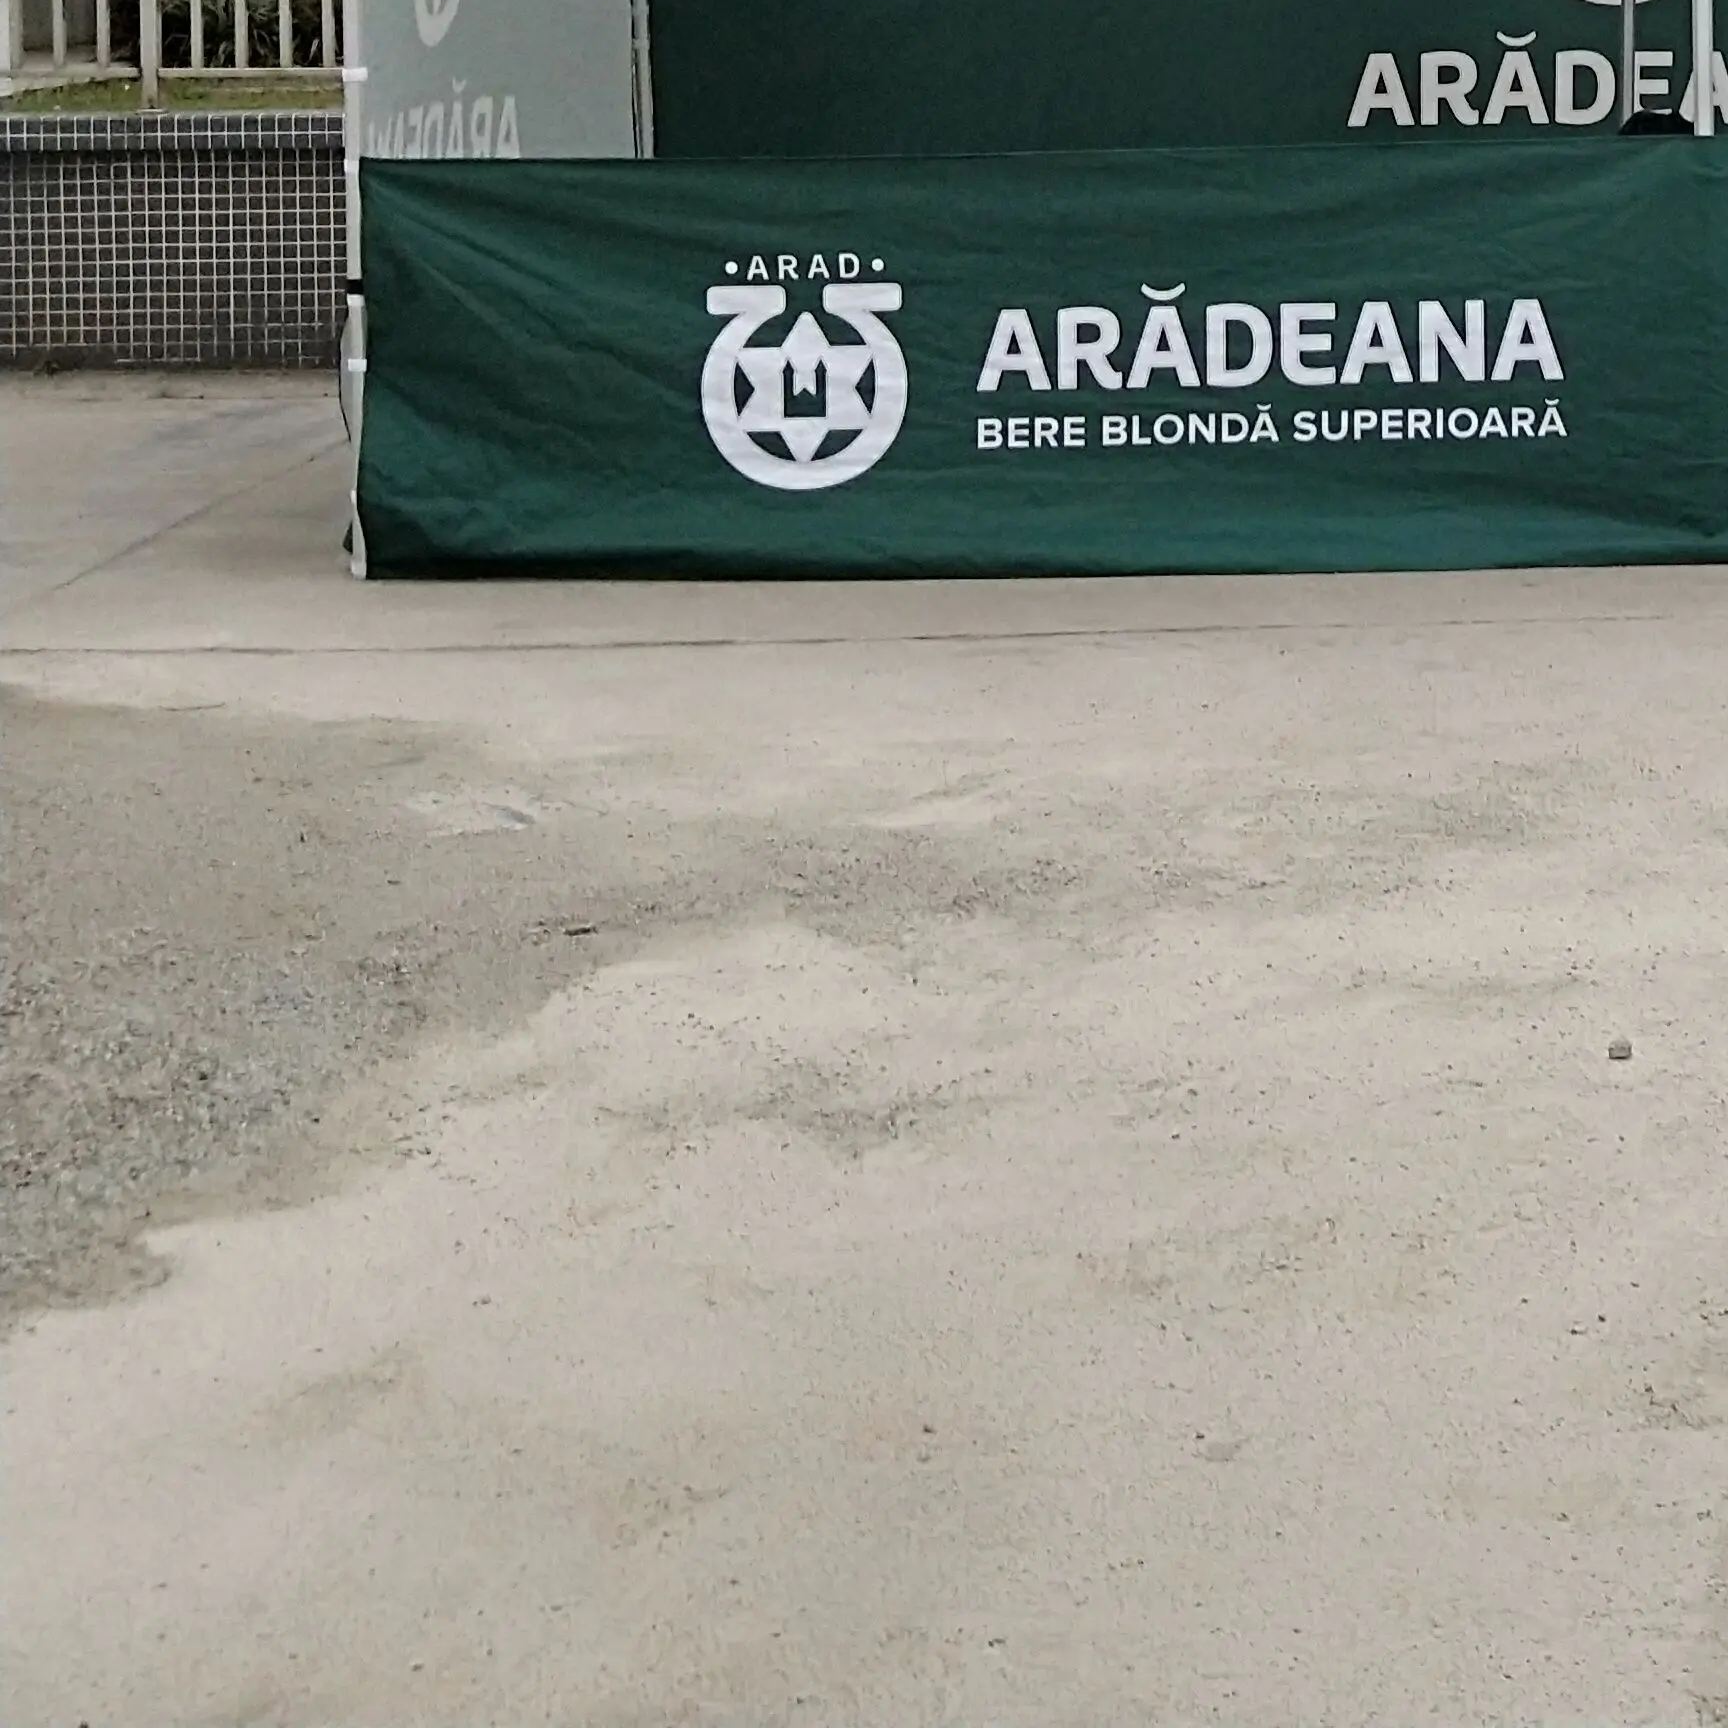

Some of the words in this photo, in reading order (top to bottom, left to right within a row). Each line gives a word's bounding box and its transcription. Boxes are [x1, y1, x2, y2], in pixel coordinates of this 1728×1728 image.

[746, 252, 860, 281] ARAD
[975, 281, 1565, 392] ARĂDEANA
[976, 415, 1087, 450] BERE
[1101, 402, 1280, 447] BLONDĂ
[1292, 397, 1568, 443] SUPERIOARĂ
